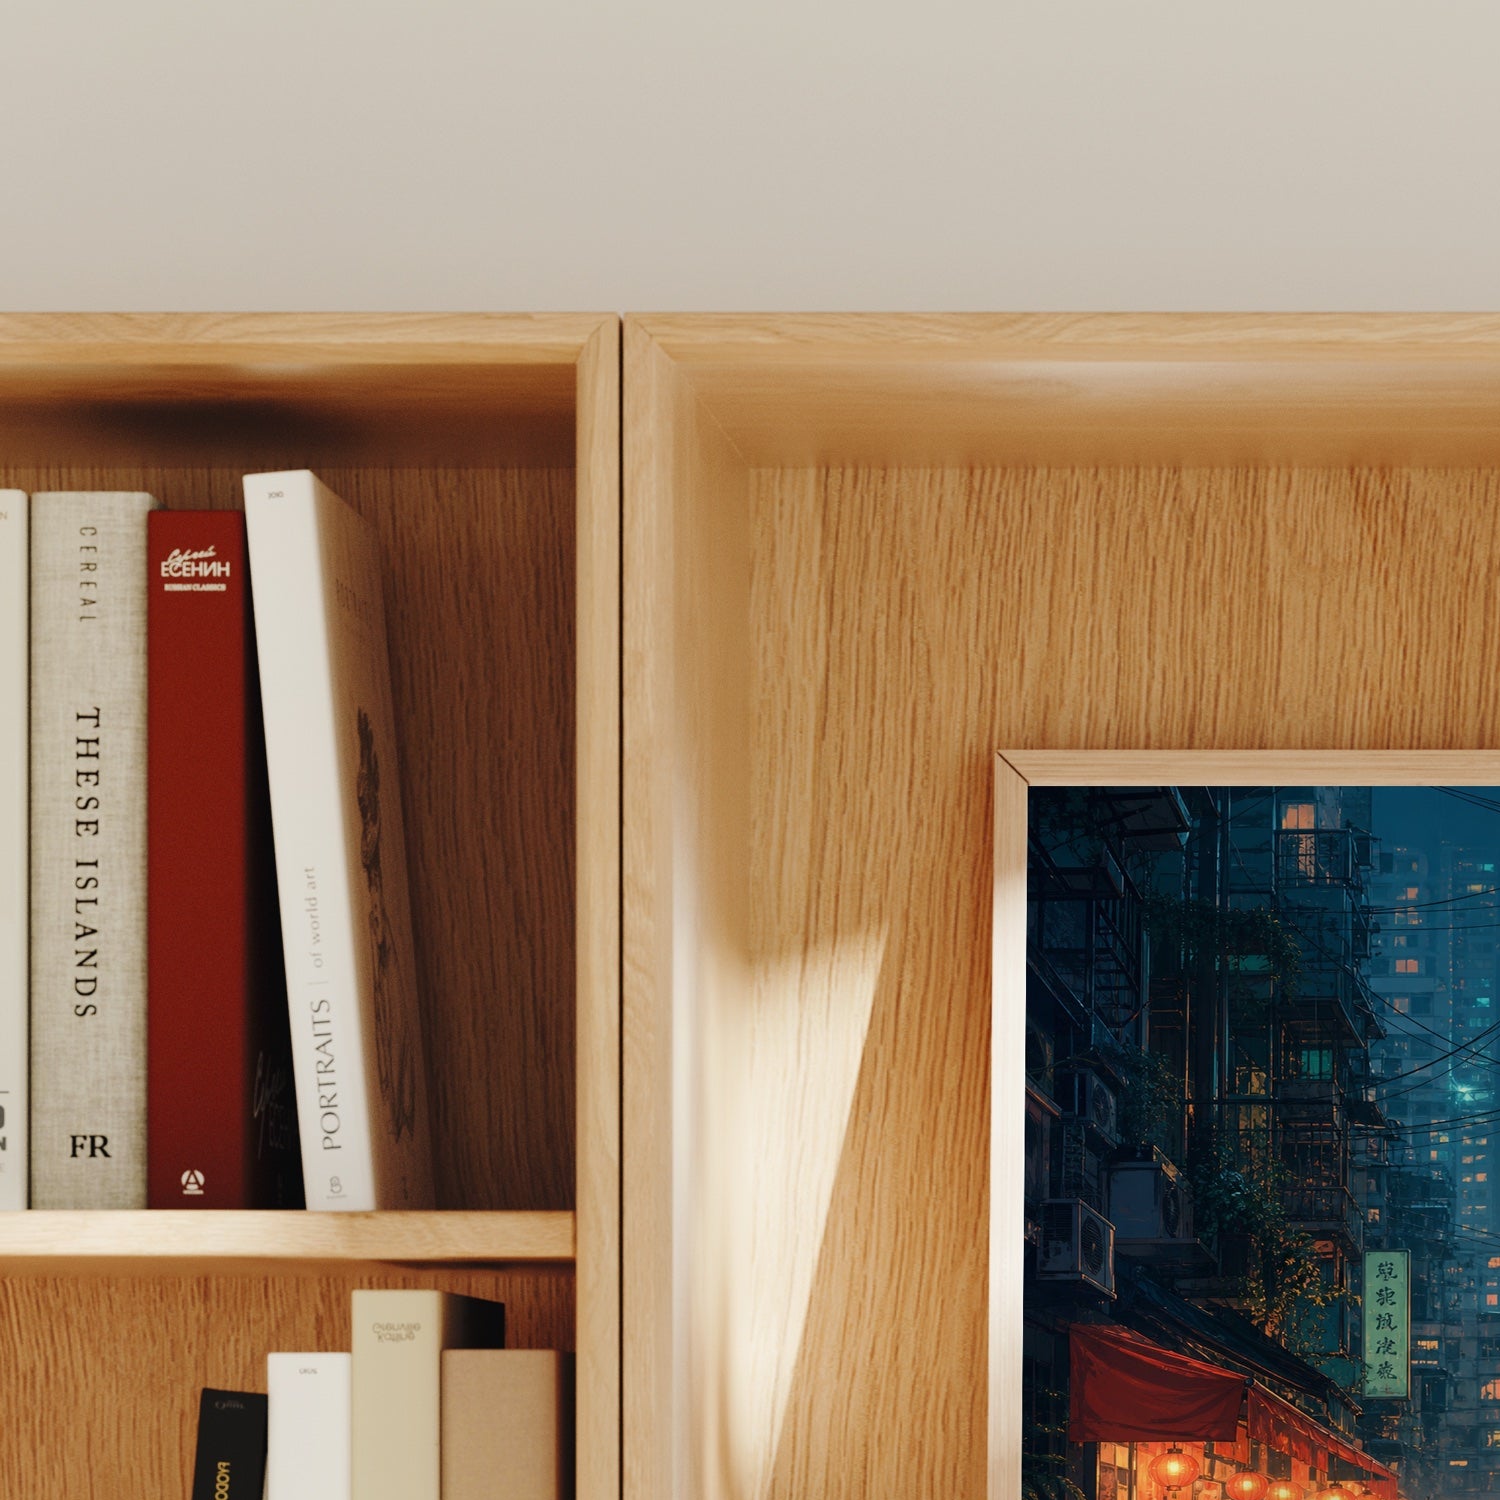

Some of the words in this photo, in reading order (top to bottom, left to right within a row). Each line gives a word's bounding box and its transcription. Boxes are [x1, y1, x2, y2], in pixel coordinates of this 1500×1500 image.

[79, 526, 98, 622] CEREAL
[160, 561, 231, 578] ЕСЕНИН
[75, 706, 101, 837] THESE
[304, 867, 316, 889] art
[74, 859, 99, 1017] ISLANDS
[304, 897, 321, 945] world
[311, 951, 323, 968] of
[310, 999, 342, 1152] PORTRAITS
[70, 1134, 112, 1158] FR
